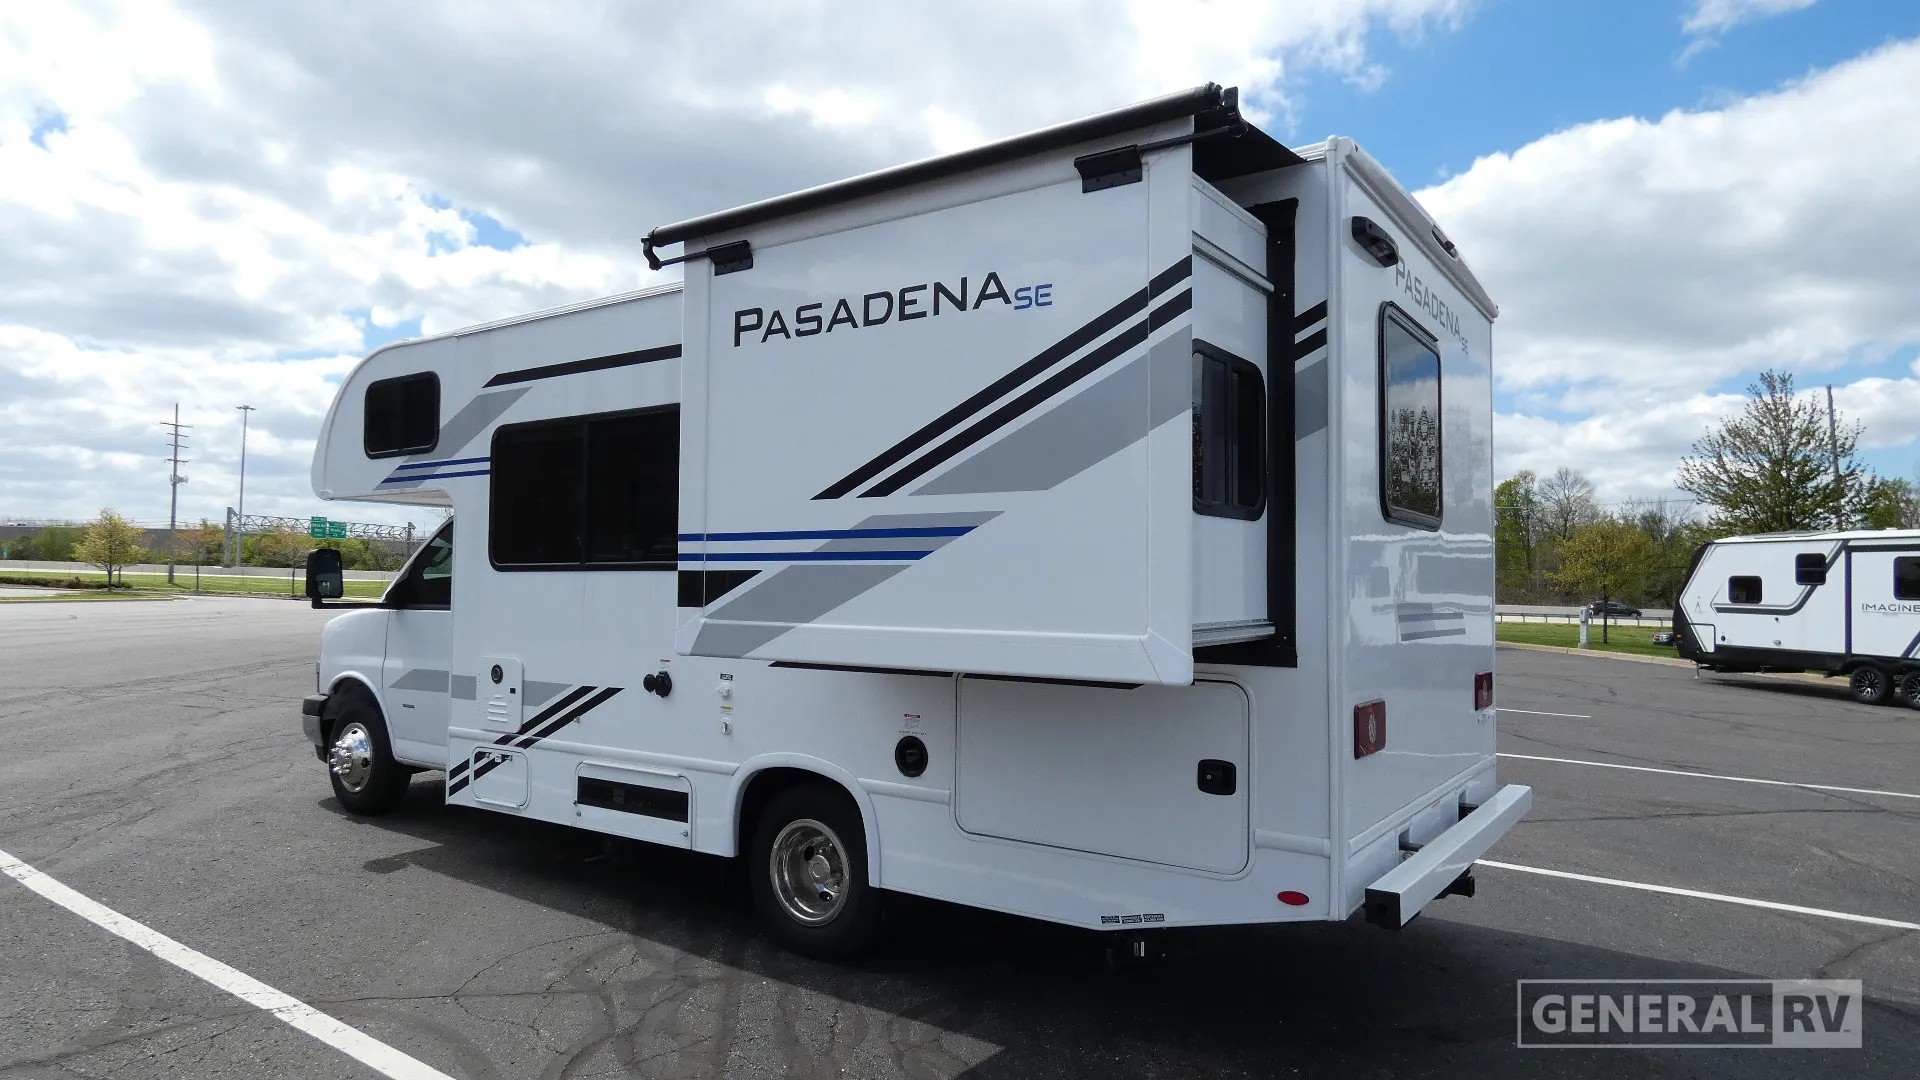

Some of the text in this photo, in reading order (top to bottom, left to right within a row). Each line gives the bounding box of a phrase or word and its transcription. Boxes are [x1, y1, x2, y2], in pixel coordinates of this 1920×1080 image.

[734, 271, 1053, 347] PASADENA SE
[1395, 255, 1461, 341] PASADENA
[1861, 603, 1920, 612] IMAGINE
